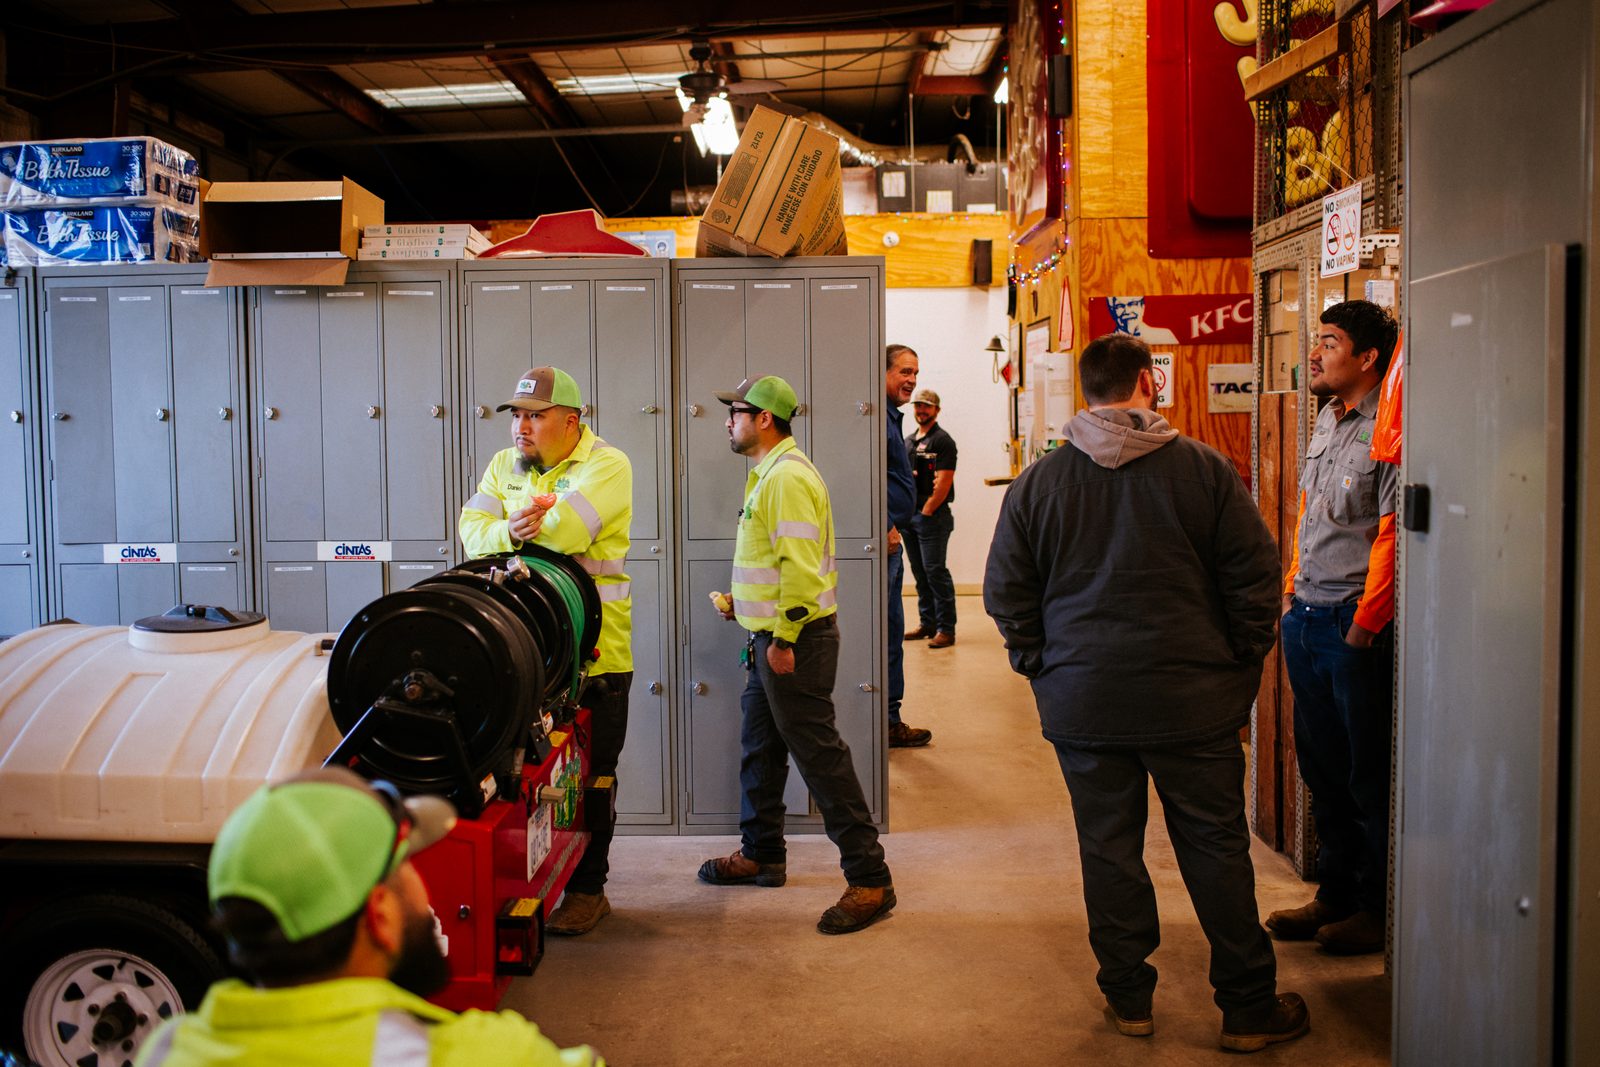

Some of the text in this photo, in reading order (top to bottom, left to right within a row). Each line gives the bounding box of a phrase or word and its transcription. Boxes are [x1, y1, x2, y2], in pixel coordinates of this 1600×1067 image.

[51, 146, 83, 154] KIRKLAND
[65, 158, 111, 179] Tissue
[776, 154, 811, 223] HANDLE WITH CARE
[780, 149, 823, 236] MANEJESE CON CUIDADO
[1325, 191, 1360, 215] NO SMOKING
[37, 222, 120, 244] Bth Tssue
[1326, 252, 1356, 271] NO VAPING
[1190, 299, 1253, 339] KFC
